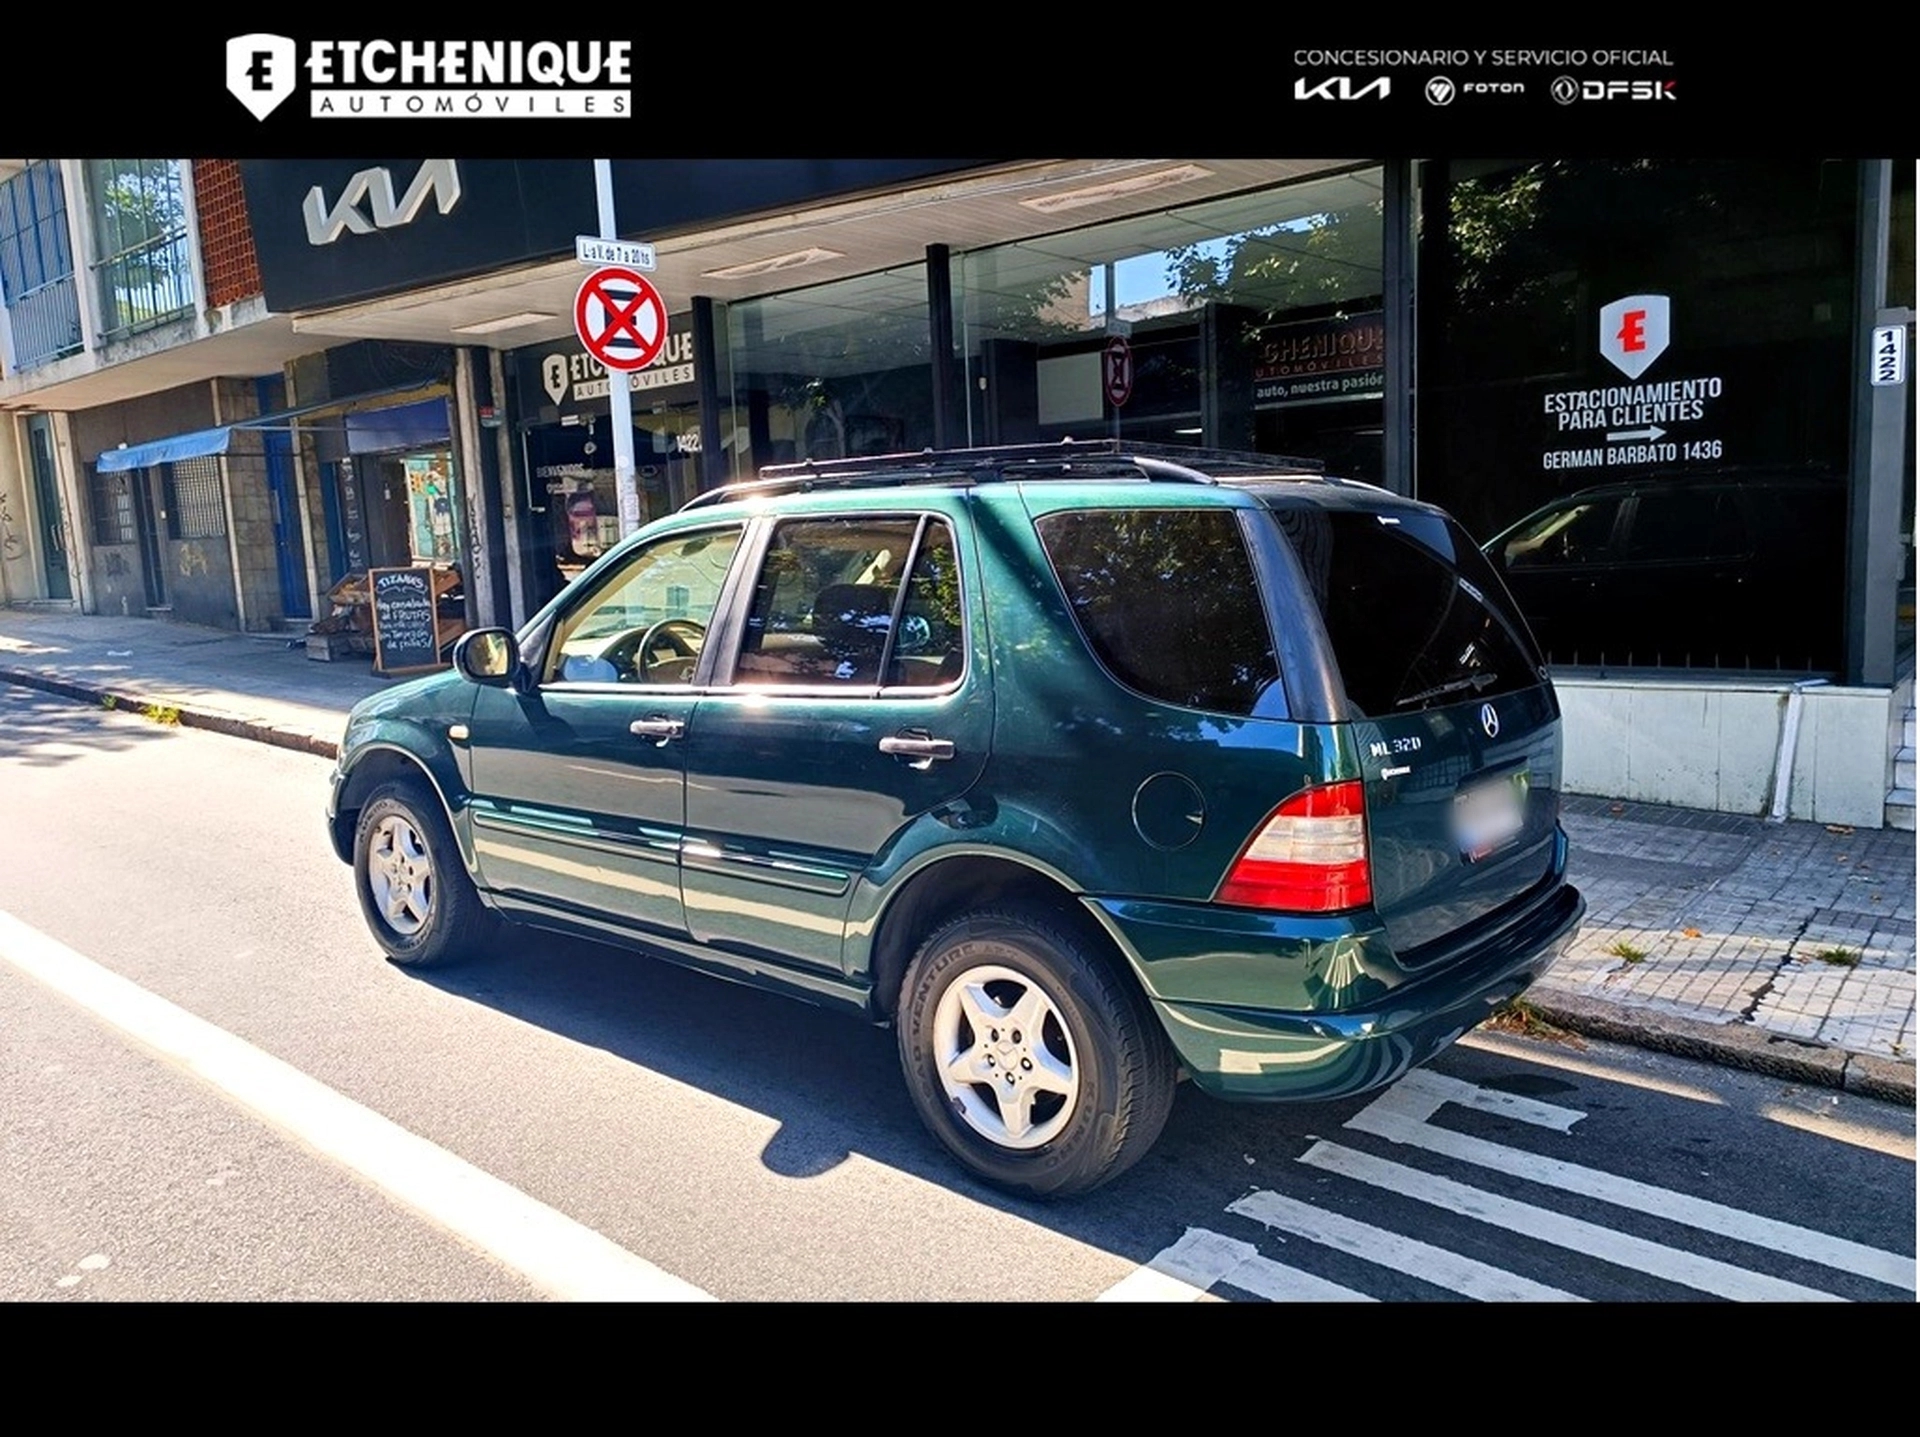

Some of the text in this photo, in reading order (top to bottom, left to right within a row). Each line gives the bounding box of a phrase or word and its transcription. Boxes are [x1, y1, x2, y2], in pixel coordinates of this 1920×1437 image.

[1878, 330, 1898, 382] 1422
[1290, 380, 1339, 395] nuestra
[1544, 378, 1723, 414] ESTACIONAMIENTO
[1558, 399, 1704, 431] PARA CLIENTES
[1543, 440, 1723, 470] GERMAN BARBATO 1436
[392, 609, 432, 622] FRUTAS
[1369, 737, 1422, 757] ML 320
[912, 943, 978, 1036] VENTURE
